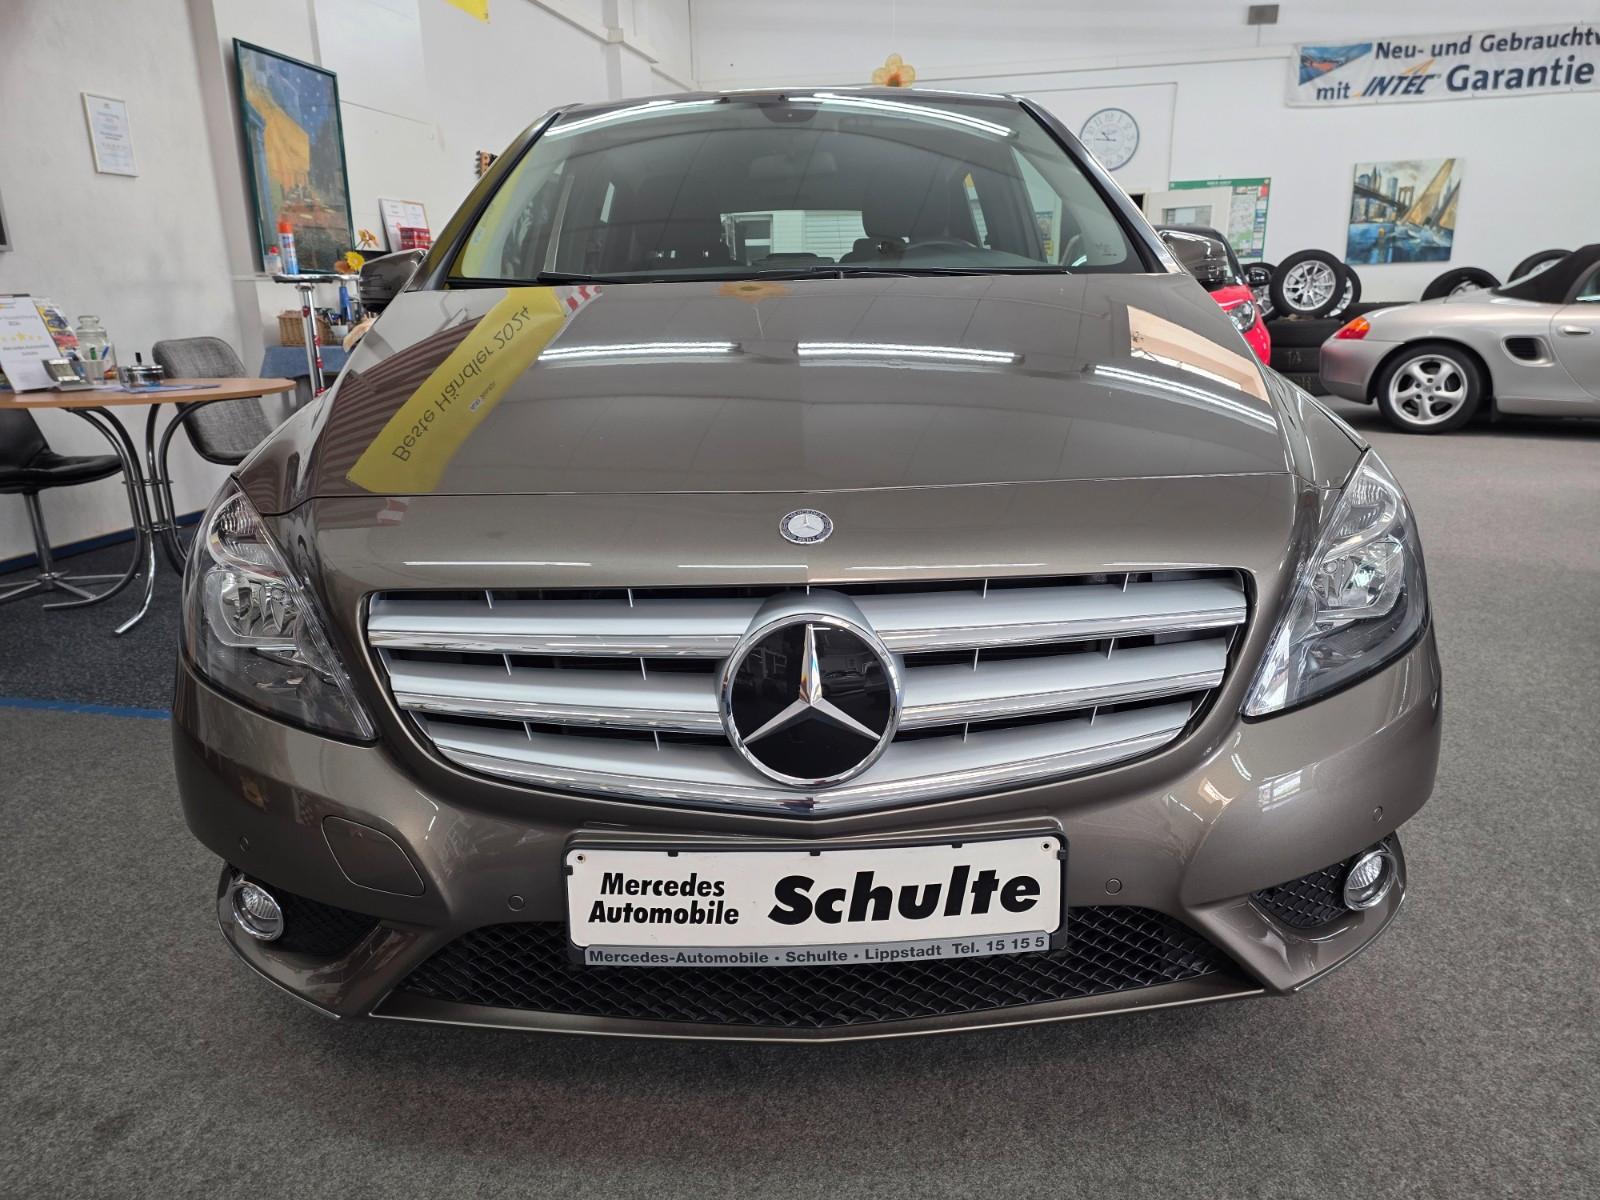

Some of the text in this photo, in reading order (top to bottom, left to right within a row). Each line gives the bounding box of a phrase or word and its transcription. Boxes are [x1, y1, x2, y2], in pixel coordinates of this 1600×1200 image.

[1376, 42, 1424, 59] Neu-
[1431, 36, 1471, 57] und
[1317, 54, 1595, 100] mit INTEC Garantie
[600, 872, 725, 897] Mercedes
[768, 865, 1041, 925] Schulte
[588, 900, 739, 925] Automobile
[589, 936, 1045, 963] Mercedes-Automobile Schulte Lippstadt Tel. 15 15 5
